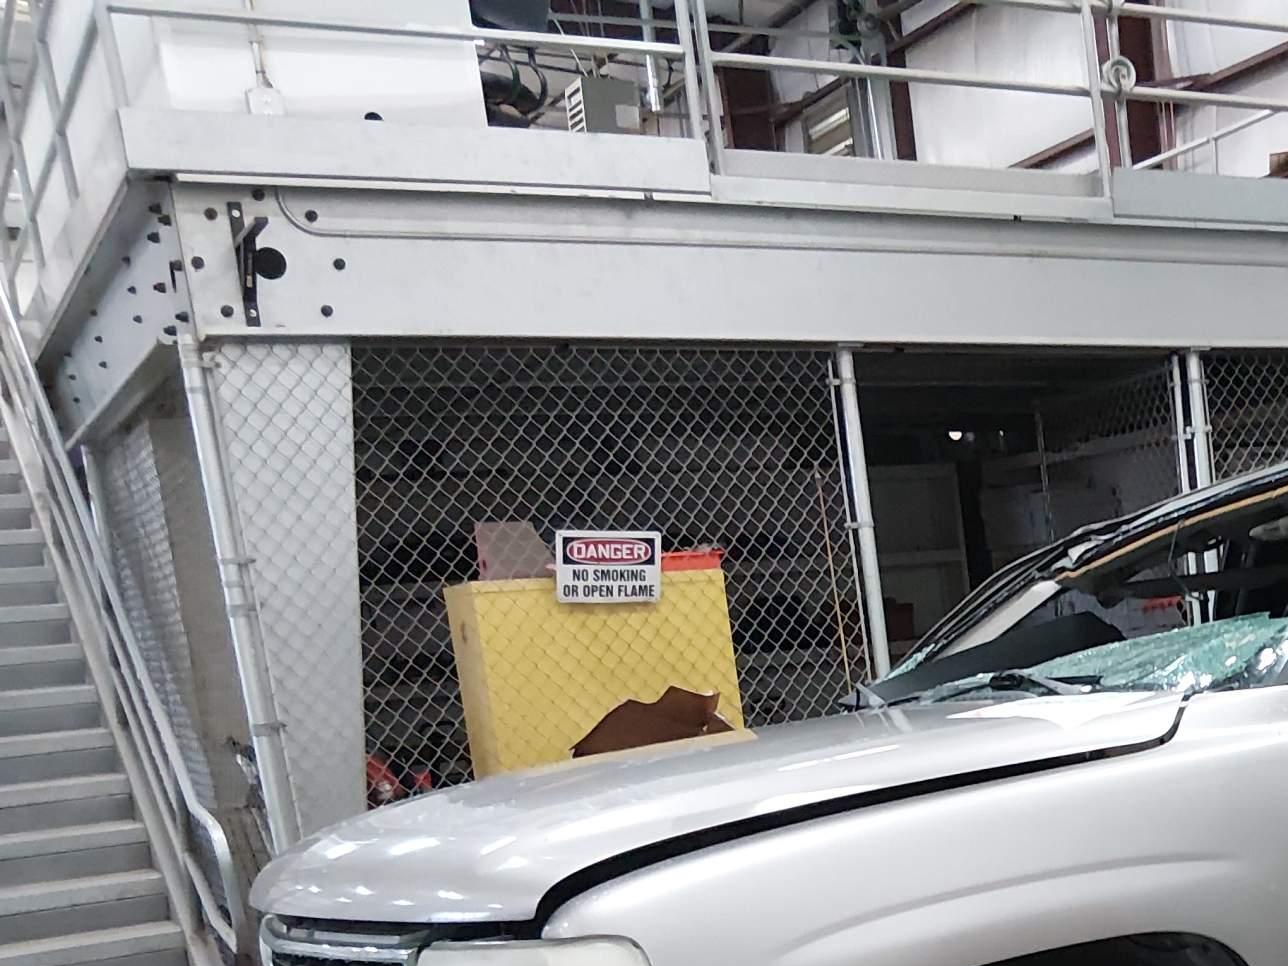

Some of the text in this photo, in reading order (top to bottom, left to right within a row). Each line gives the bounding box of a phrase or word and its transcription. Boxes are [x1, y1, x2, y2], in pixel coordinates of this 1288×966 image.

[573, 543, 646, 559] DANGER
[572, 569, 646, 582] NO SMOKING
[563, 584, 655, 598] OR OPEN FLAME
